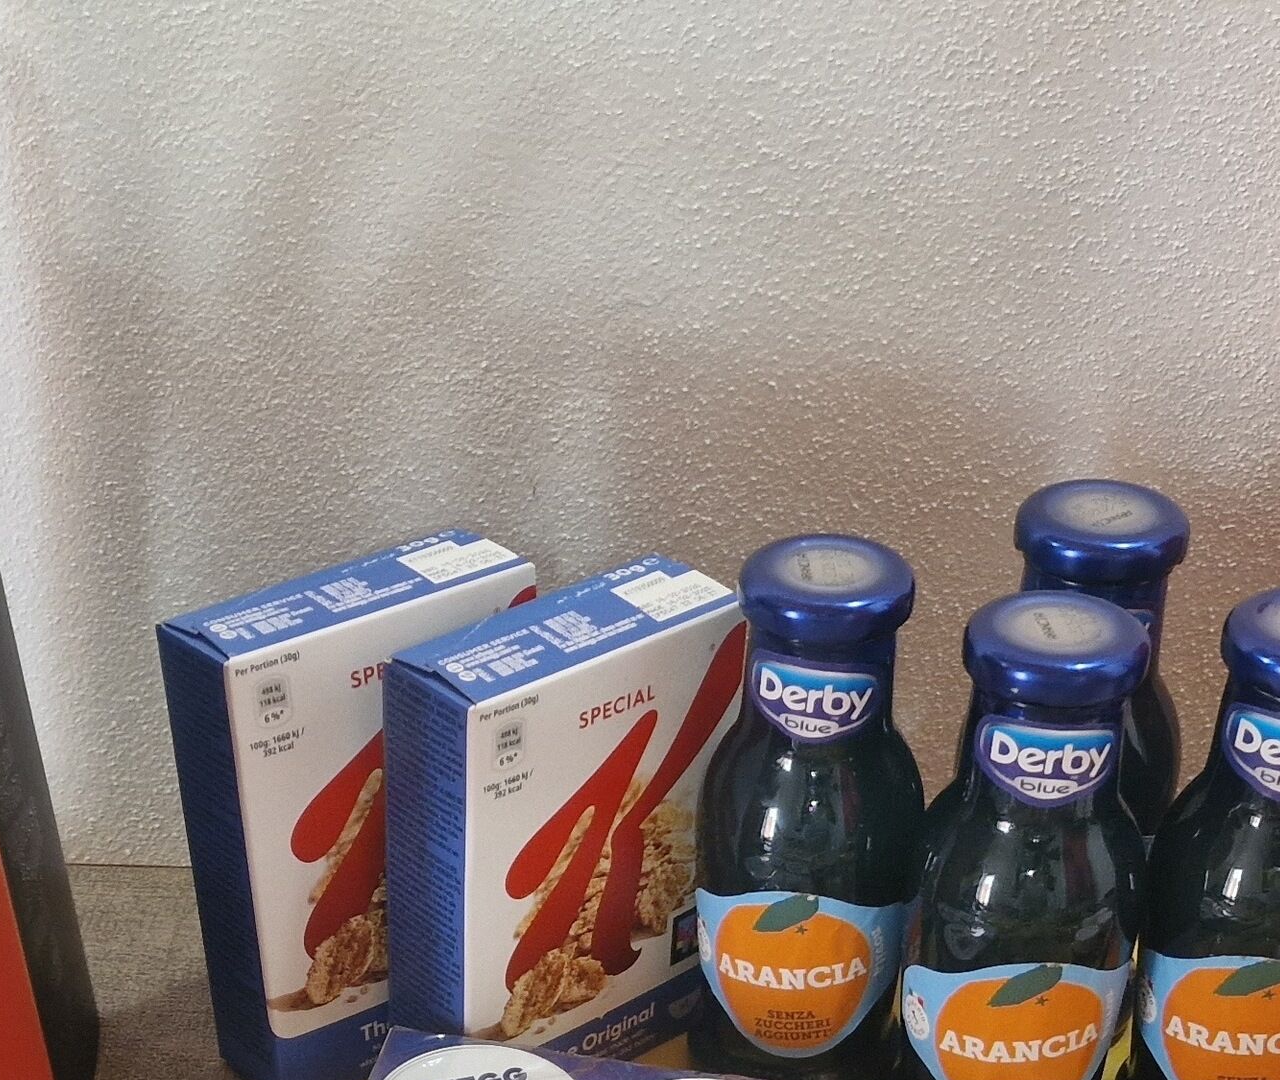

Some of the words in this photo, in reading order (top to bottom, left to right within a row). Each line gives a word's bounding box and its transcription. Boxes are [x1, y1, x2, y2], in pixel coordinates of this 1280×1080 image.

[235, 666, 248, 677] Per
[250, 659, 278, 672] Portion
[280, 651, 300, 664] (30g)
[759, 666, 873, 720] Derby
[480, 714, 491, 722] Per
[494, 703, 520, 717] Portion
[521, 694, 539, 708] (30g)
[578, 685, 656, 730] SPECIAL
[785, 716, 832, 734] blue
[272, 733, 290, 744] 1660
[278, 742, 294, 754] kcal
[990, 732, 1111, 776] Derby
[508, 783, 522, 794] kcal
[1019, 779, 1071, 794] blue
[720, 953, 868, 990] ARANCIA
[582, 1002, 655, 1050] Original
[754, 1017, 831, 1030] ZUCCHERI
[767, 1009, 816, 1020] SENZA
[939, 1022, 1098, 1063] ARANCIA
